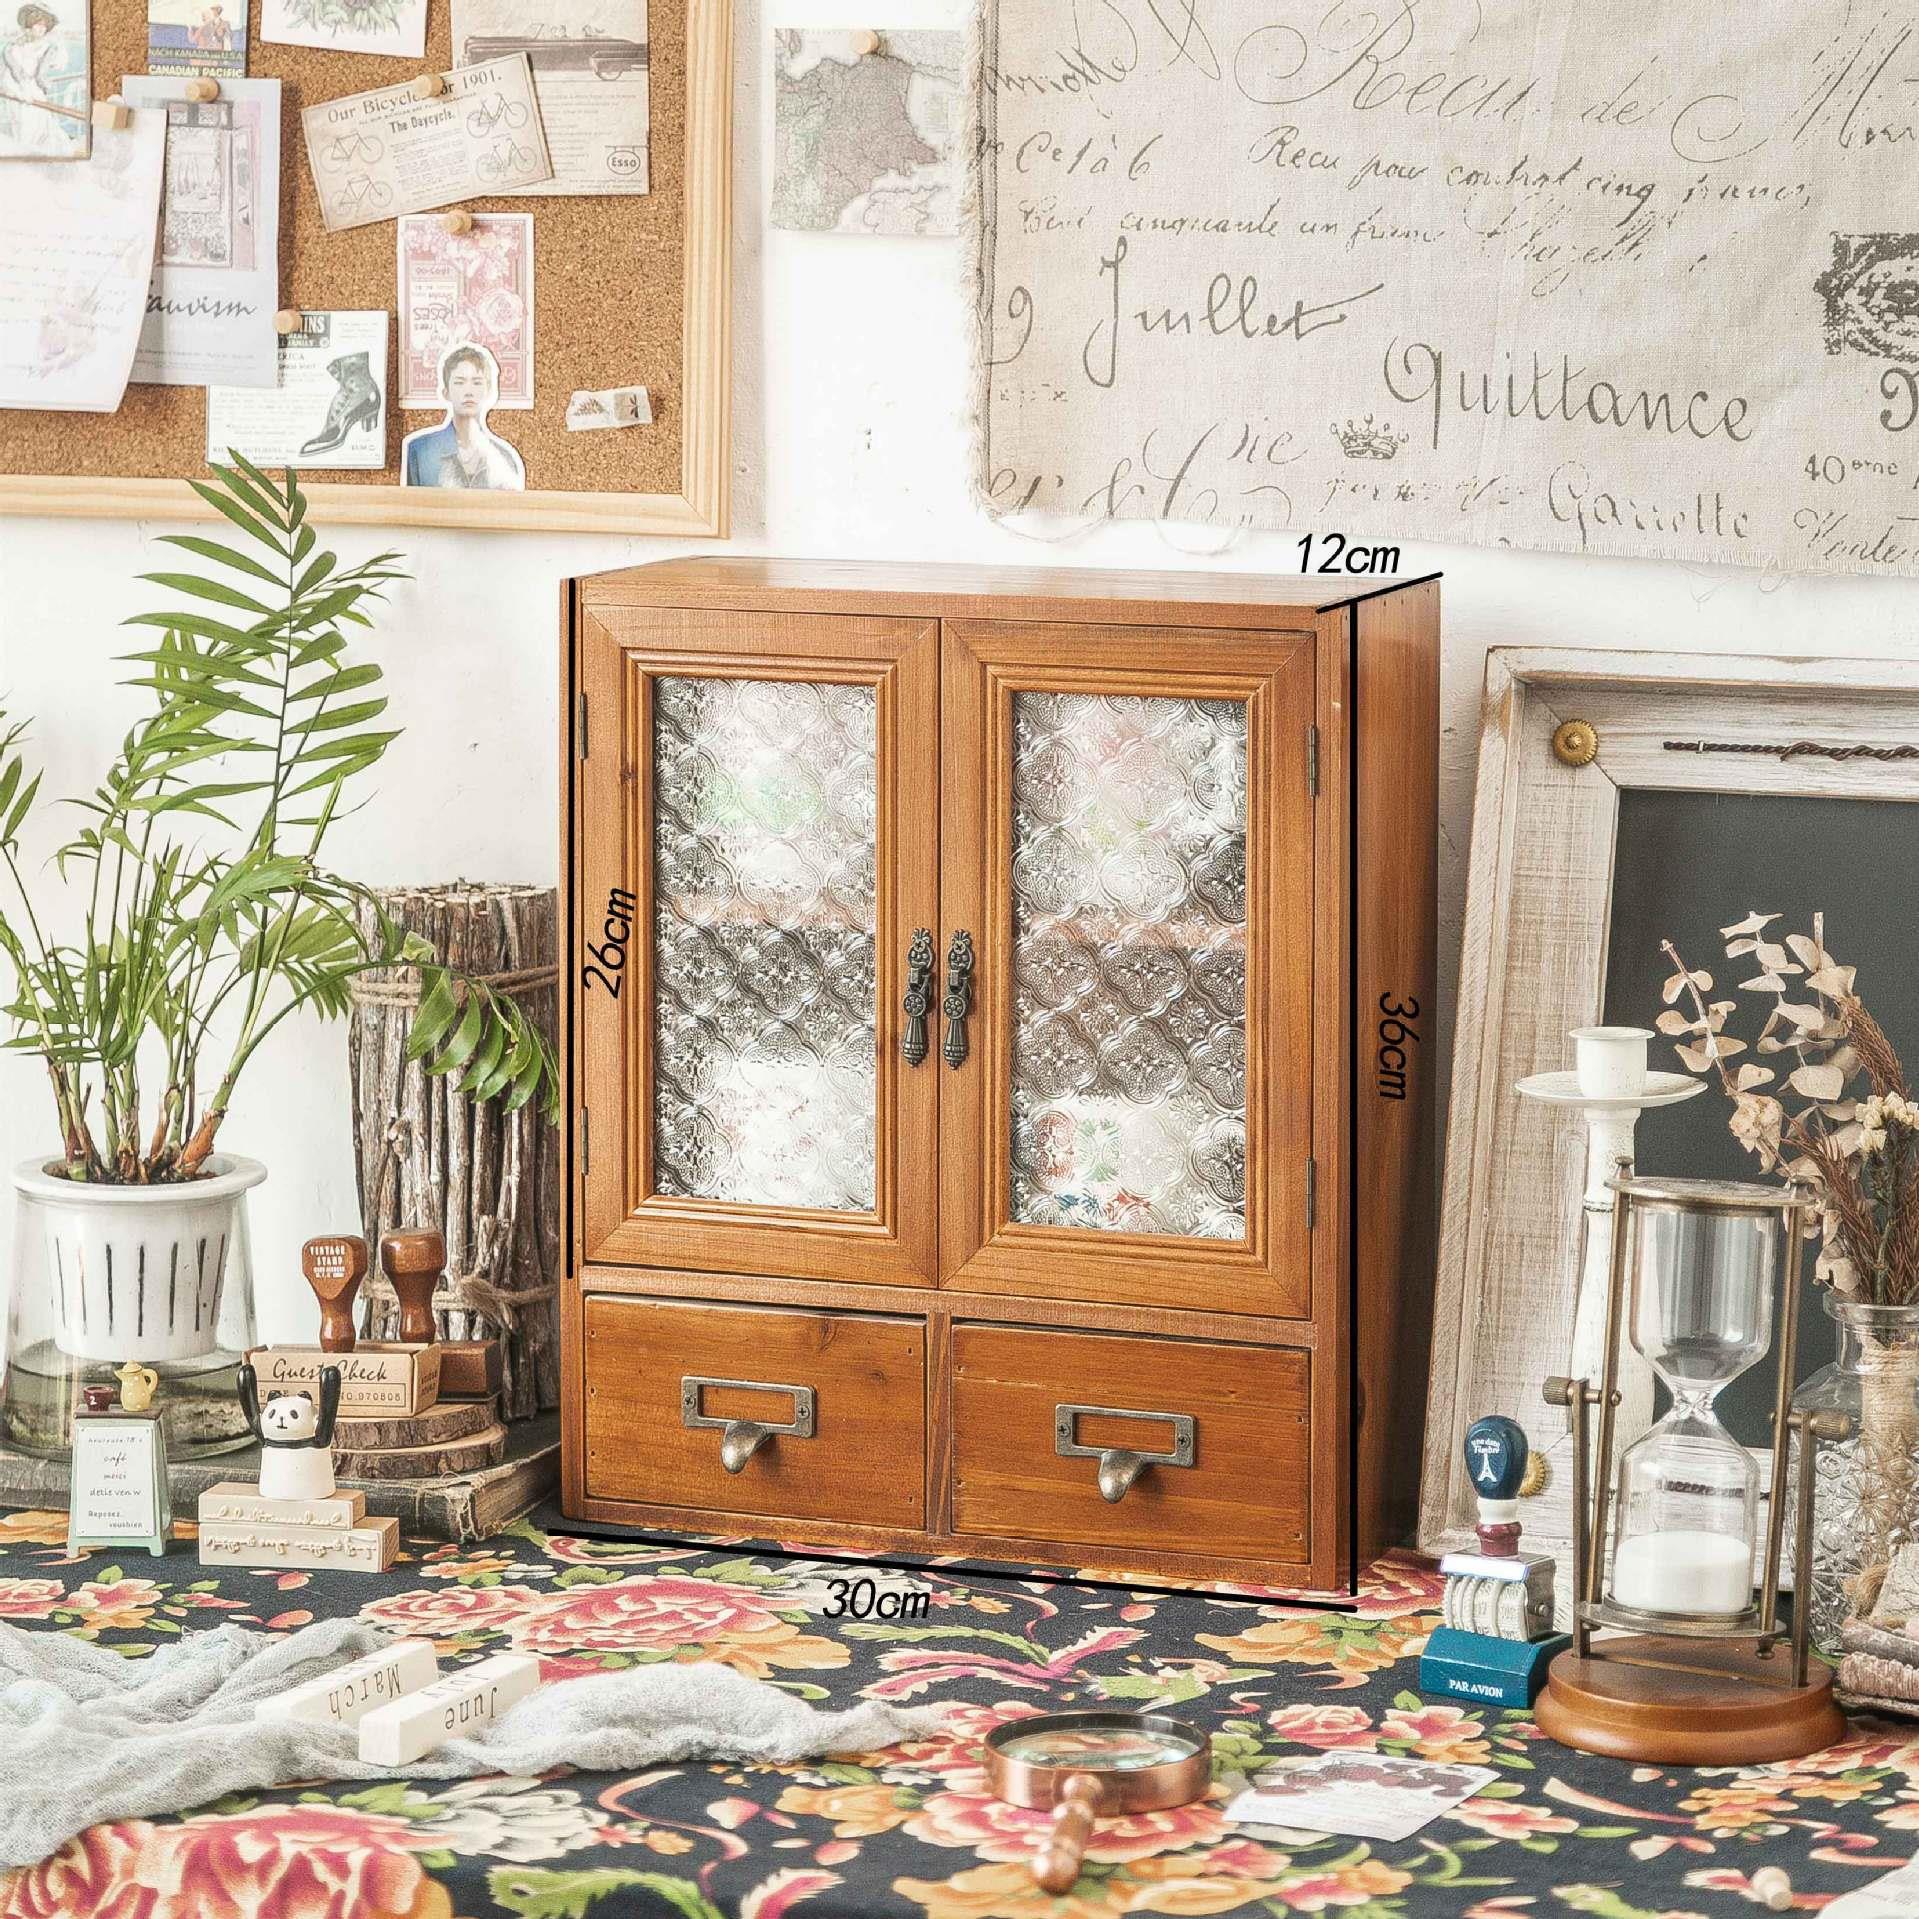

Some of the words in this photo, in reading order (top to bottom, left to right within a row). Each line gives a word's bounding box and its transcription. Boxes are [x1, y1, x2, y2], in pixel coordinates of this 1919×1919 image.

[149, 64, 200, 76] CANADIAN
[202, 67, 244, 78] PACIFIC
[328, 107, 356, 123] Our
[389, 120, 408, 134] The
[145, 280, 258, 318] auvism
[1083, 236, 1384, 388] Juillet
[1384, 336, 1754, 450] Quittance
[310, 1245, 345, 1256] VINTAGE
[335, 1359, 388, 1381] Check
[90, 1395, 98, 1405] 2
[329, 1663, 401, 1720] March
[1449, 1679, 1470, 1693] PAR
[1470, 1684, 1503, 1698] AVION
[445, 1687, 498, 1730] June
